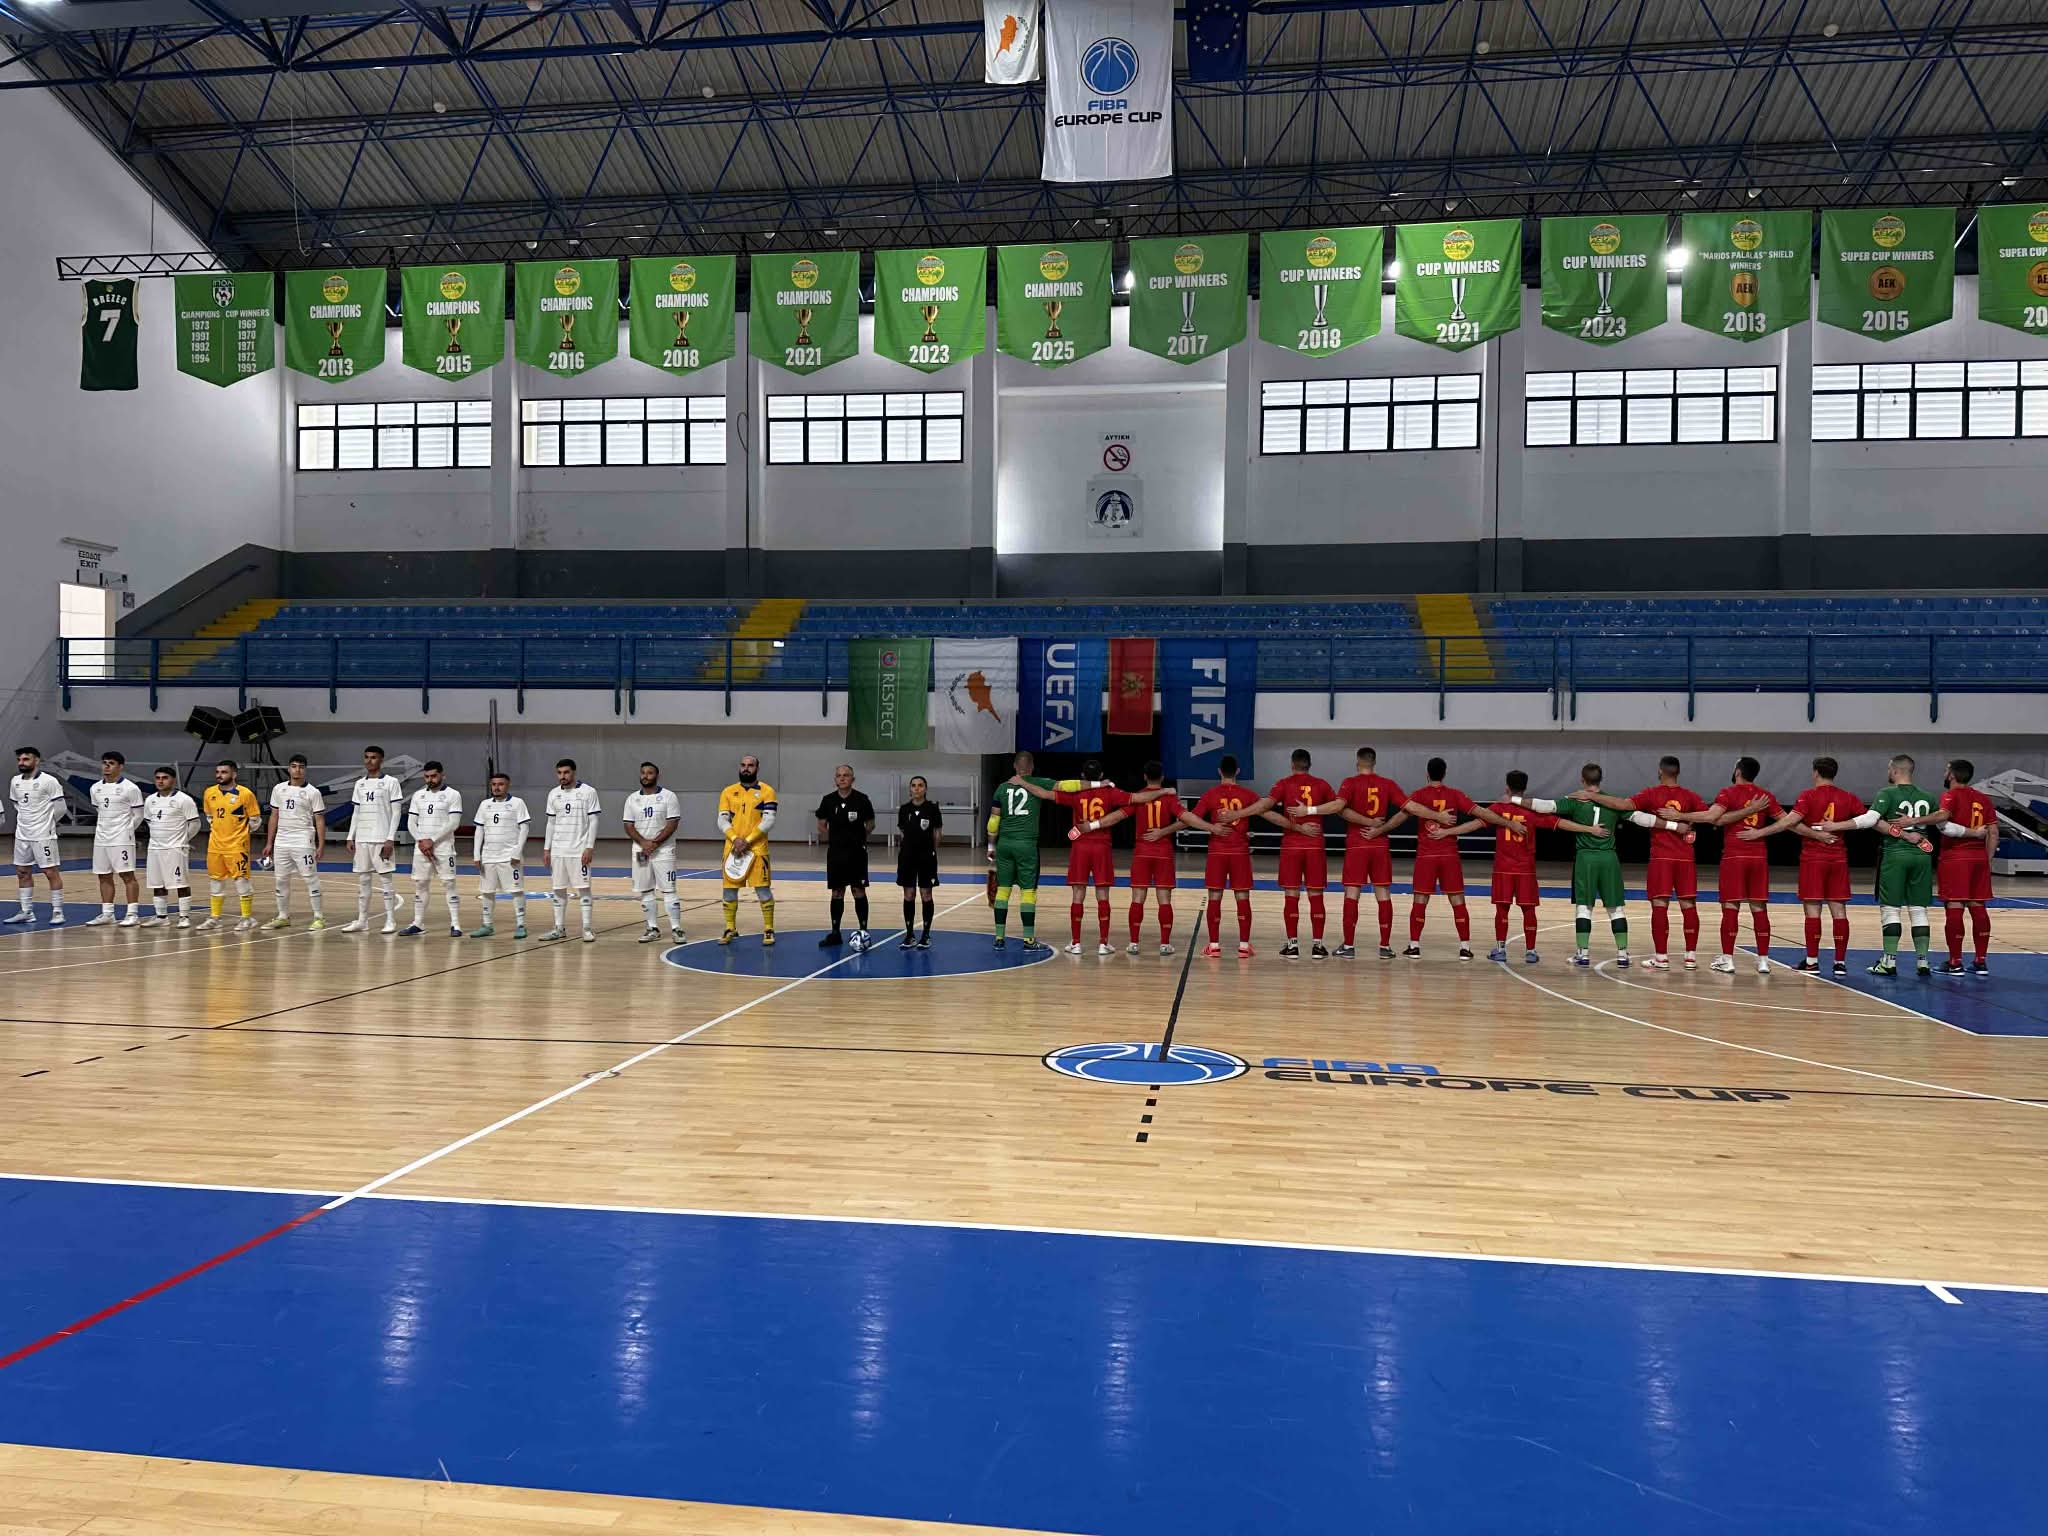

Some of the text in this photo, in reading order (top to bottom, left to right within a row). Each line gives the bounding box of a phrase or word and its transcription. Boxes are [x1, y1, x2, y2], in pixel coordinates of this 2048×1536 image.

[1088, 99, 1127, 111] FIBA
[1054, 112, 1162, 127] EUROPE CUP
[1841, 251, 1934, 261] SUPER CUP WINNERS
[2000, 247, 2047, 258] SUPER CUP
[1417, 260, 1500, 276] CUP WINNERS
[1563, 254, 1646, 269] CUP WINNERS
[1730, 262, 1761, 270] WINNERS
[1150, 273, 1228, 289] CUP WINNERS
[1280, 266, 1361, 282] CUP WINNERS
[1025, 282, 1083, 298] CHAMPIONS
[1736, 282, 1753, 293] AEK
[1878, 279, 1896, 288] AEK
[93, 294, 127, 306] BREZEC
[656, 293, 709, 308] CHAMPIONS
[777, 290, 832, 305] CHAMPIONS
[902, 286, 958, 302] CHAMPIONS
[310, 304, 361, 318] CHAMPIONS
[426, 301, 480, 315] CHAMPIONS
[540, 297, 592, 311] CHAMPIONS
[181, 310, 220, 319] CHAMPIONS
[225, 309, 270, 318] CUP WINNERS
[1862, 310, 1909, 331] 2015
[100, 310, 121, 342] 7
[192, 320, 210, 330] 1973
[238, 320, 256, 329] 1969
[1580, 317, 1626, 337] 2023
[1723, 312, 1766, 332] 2013
[192, 332, 209, 340] 1991
[238, 331, 256, 340] 1970
[1436, 322, 1479, 343] 2021
[192, 342, 210, 352] 1992
[238, 341, 254, 351] 1971
[1032, 341, 1075, 360] 2025
[1168, 335, 1208, 355] 2017
[192, 354, 210, 363] 1994
[238, 352, 256, 362] 1972
[549, 352, 584, 369] 2016
[664, 349, 699, 367] 2018
[786, 347, 821, 365] 2021
[909, 345, 949, 363] 2023
[238, 364, 256, 373] 1992
[318, 358, 354, 376] 2013
[436, 355, 472, 373] 2015
[80, 560, 98, 568] EXIT
[1045, 643, 1075, 746] UEFA
[881, 674, 895, 739] RESPECT
[1191, 658, 1226, 757] FIFA
[24, 793, 29, 803] 5
[104, 798, 109, 808] 3
[366, 792, 374, 802] 14
[1006, 788, 1029, 816] 12
[1300, 785, 1312, 808] 3
[1367, 788, 1379, 816] 5
[286, 800, 294, 809] 13
[428, 804, 433, 814] 8
[565, 803, 571, 814] 9
[742, 802, 746, 814] 1
[1080, 798, 1104, 822] 16
[157, 810, 162, 820] 4
[216, 808, 225, 818] 12
[494, 814, 499, 824] 6
[644, 806, 653, 818] 10
[1146, 800, 1162, 830] 11
[1593, 806, 1600, 827] 1
[1822, 802, 1834, 822] 4
[1898, 800, 1930, 830] 20
[1970, 802, 1983, 830] 6
[1503, 812, 1526, 842] 15
[44, 846, 50, 856] 5
[122, 850, 128, 860] 3
[236, 861, 246, 871] 12
[303, 855, 314, 865] 13
[449, 857, 454, 867] 8
[175, 866, 181, 877] 4
[513, 870, 519, 880] 6
[582, 865, 587, 876] 9
[667, 871, 676, 881] 10
[1264, 1058, 1440, 1075] FIBA
[1264, 1070, 1791, 1102] EUROPE CUP
